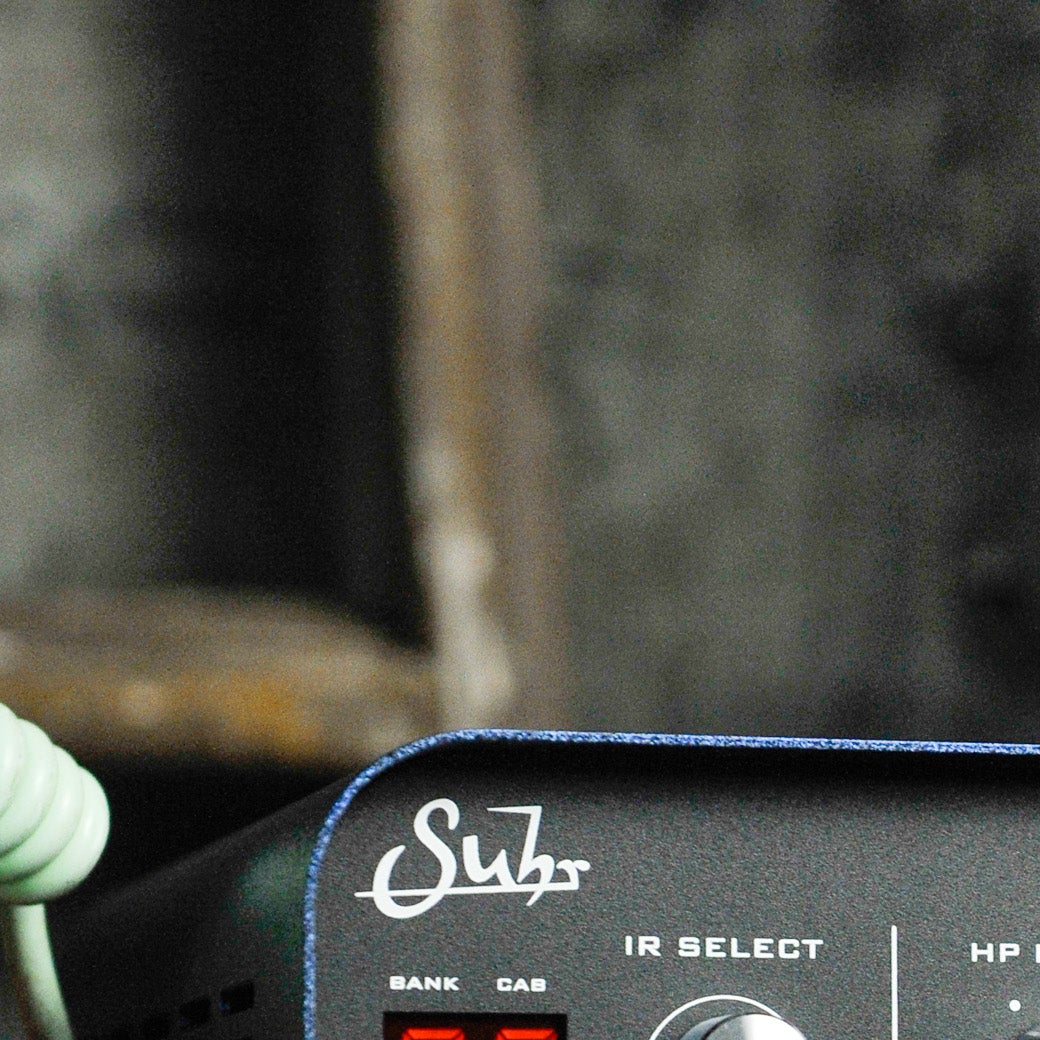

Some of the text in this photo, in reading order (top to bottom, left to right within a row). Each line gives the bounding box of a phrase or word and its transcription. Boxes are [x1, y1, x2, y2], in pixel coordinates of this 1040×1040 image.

[353, 798, 592, 919] Suhr
[624, 935, 825, 961] IR SELECT
[970, 942, 1021, 964] HP
[388, 975, 461, 992] BANK
[496, 976, 548, 993] CAB
